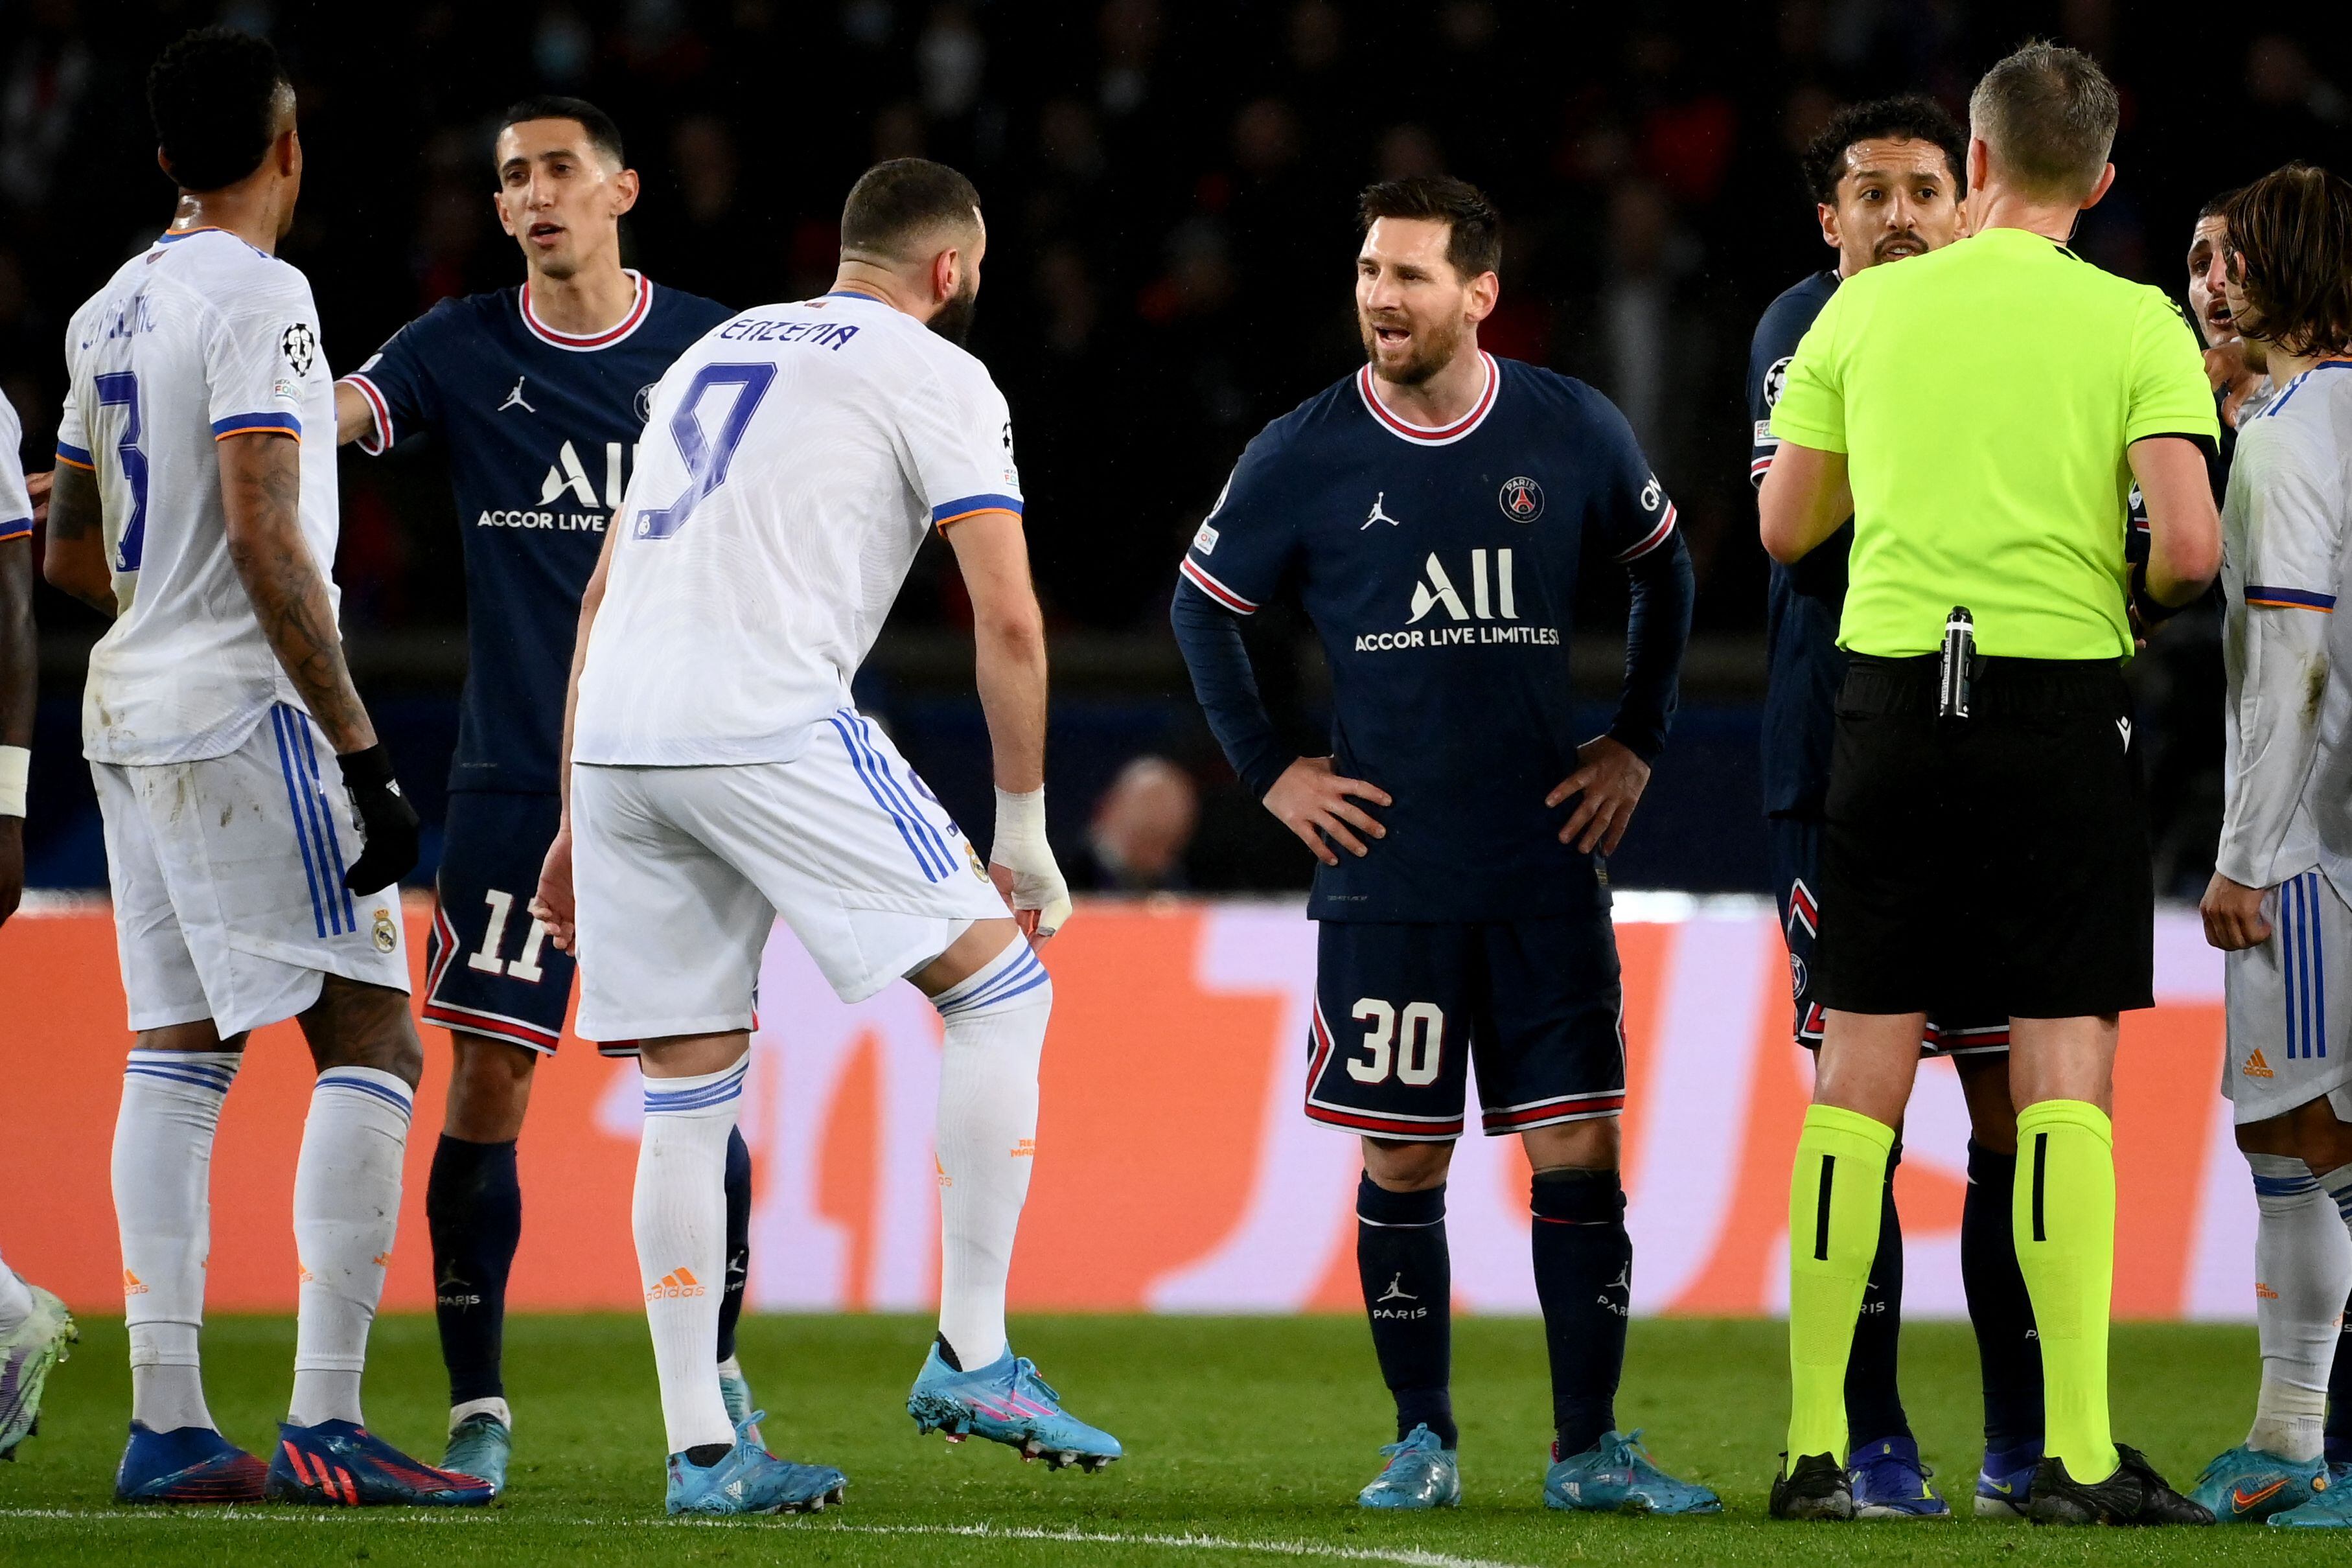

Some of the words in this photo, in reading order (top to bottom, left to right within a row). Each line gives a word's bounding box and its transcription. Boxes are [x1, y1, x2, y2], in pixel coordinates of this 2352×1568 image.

[714, 319, 860, 351] ENZEMA
[633, 362, 778, 540] 9
[94, 370, 150, 573] 3
[1506, 479, 1536, 491] PARIS
[477, 510, 553, 529] ACCOR
[559, 513, 605, 532] LIVE
[1355, 630, 1425, 652] ACCOR
[1429, 627, 1476, 647] LIVE
[467, 889, 546, 983] 11
[1346, 997, 1446, 1087] 30
[438, 1295, 481, 1306] PARIS
[646, 1284, 706, 1302] adidas
[1373, 1307, 1427, 1320] PARIS
